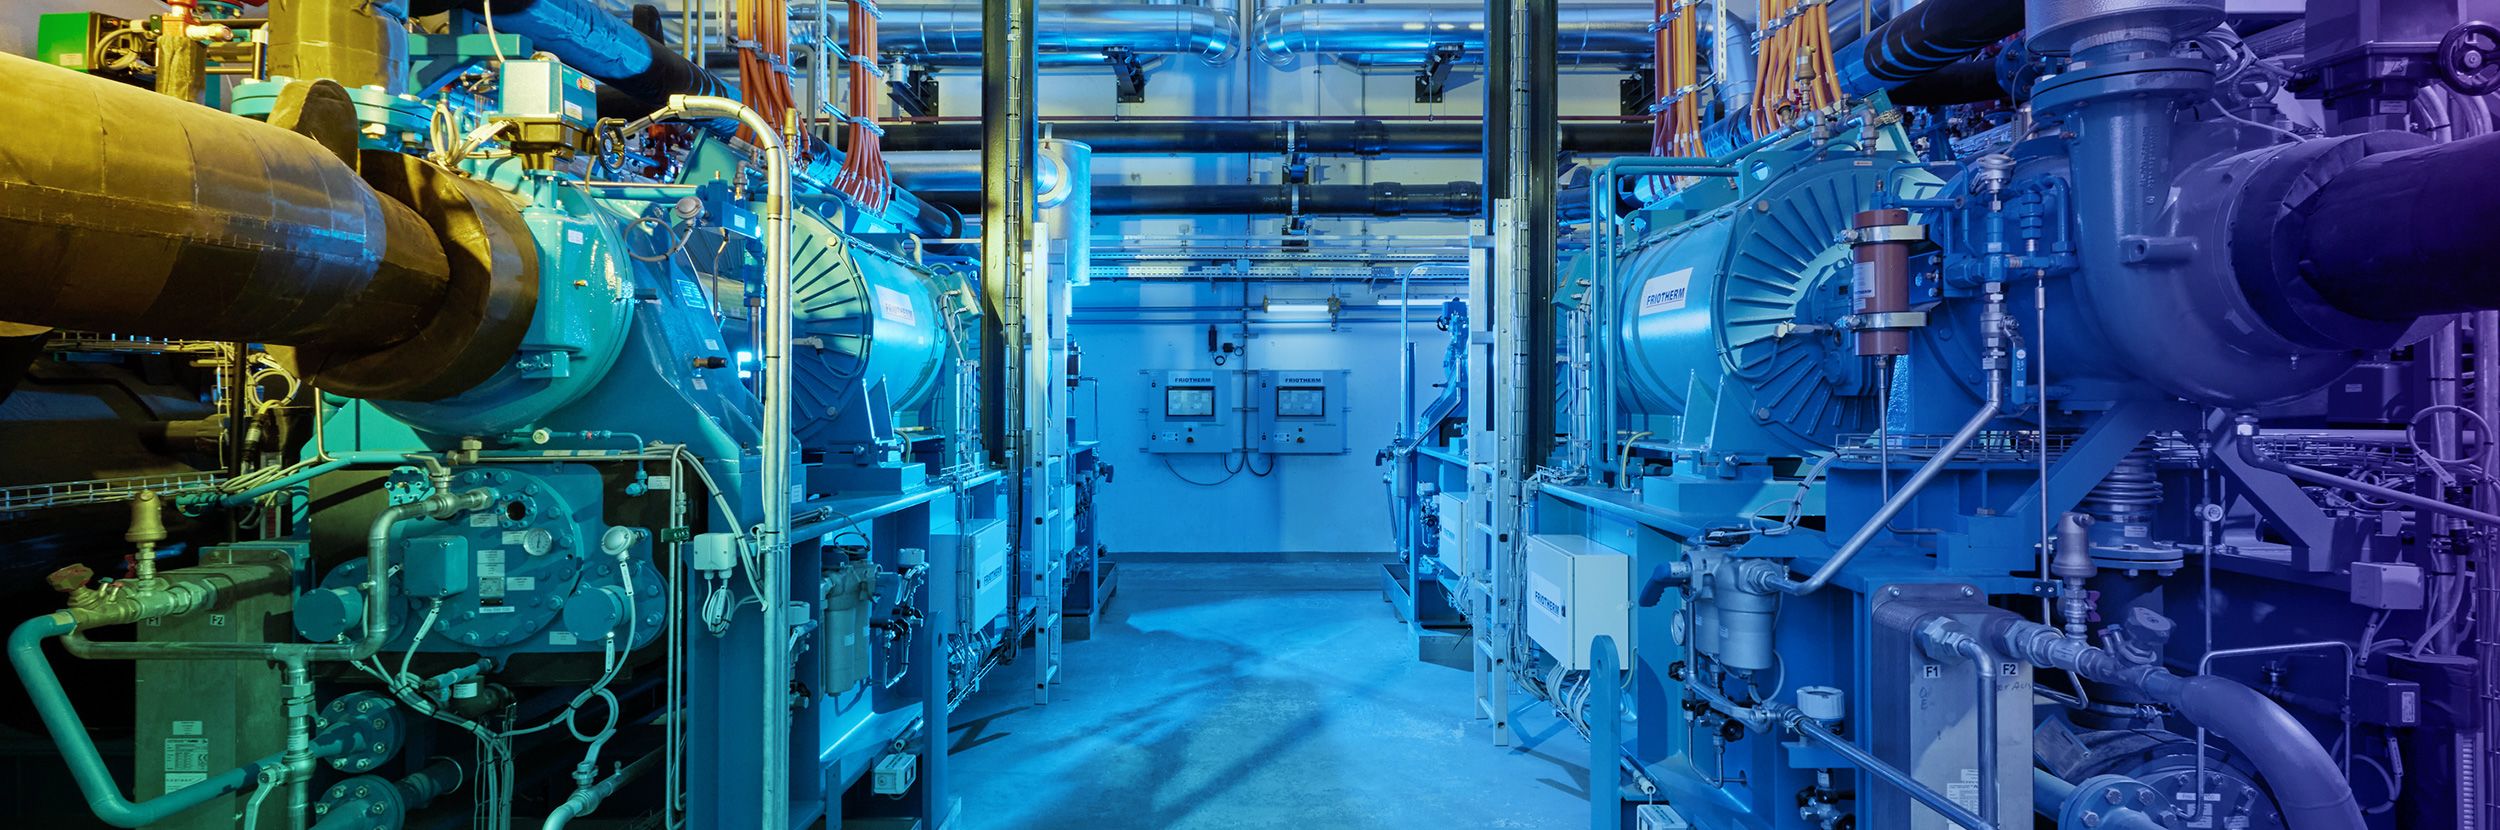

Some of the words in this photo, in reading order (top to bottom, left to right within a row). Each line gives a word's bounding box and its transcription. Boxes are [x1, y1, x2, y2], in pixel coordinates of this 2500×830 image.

[1647, 287, 1685, 306] FRIOTHERM
[1535, 590, 1560, 615] FRIOTHERM
[211, 615, 223, 625] F2
[1926, 666, 1938, 677] F1
[2003, 664, 2016, 675] F2
